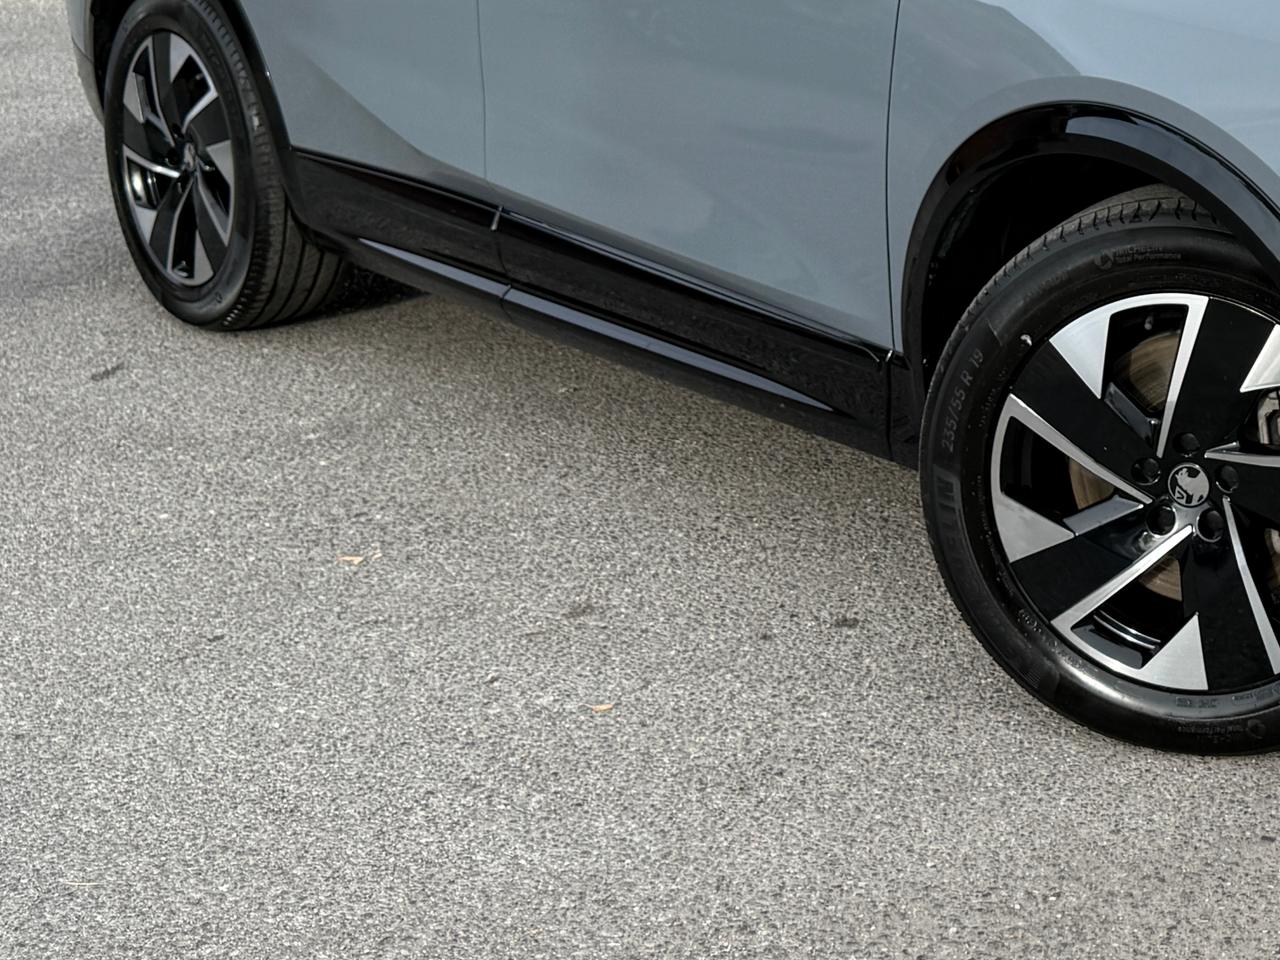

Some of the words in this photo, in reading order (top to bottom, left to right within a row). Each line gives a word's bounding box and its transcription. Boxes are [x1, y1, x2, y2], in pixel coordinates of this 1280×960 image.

[941, 385, 966, 454] 235/55
[960, 369, 974, 387] R
[968, 347, 984, 369] 19
